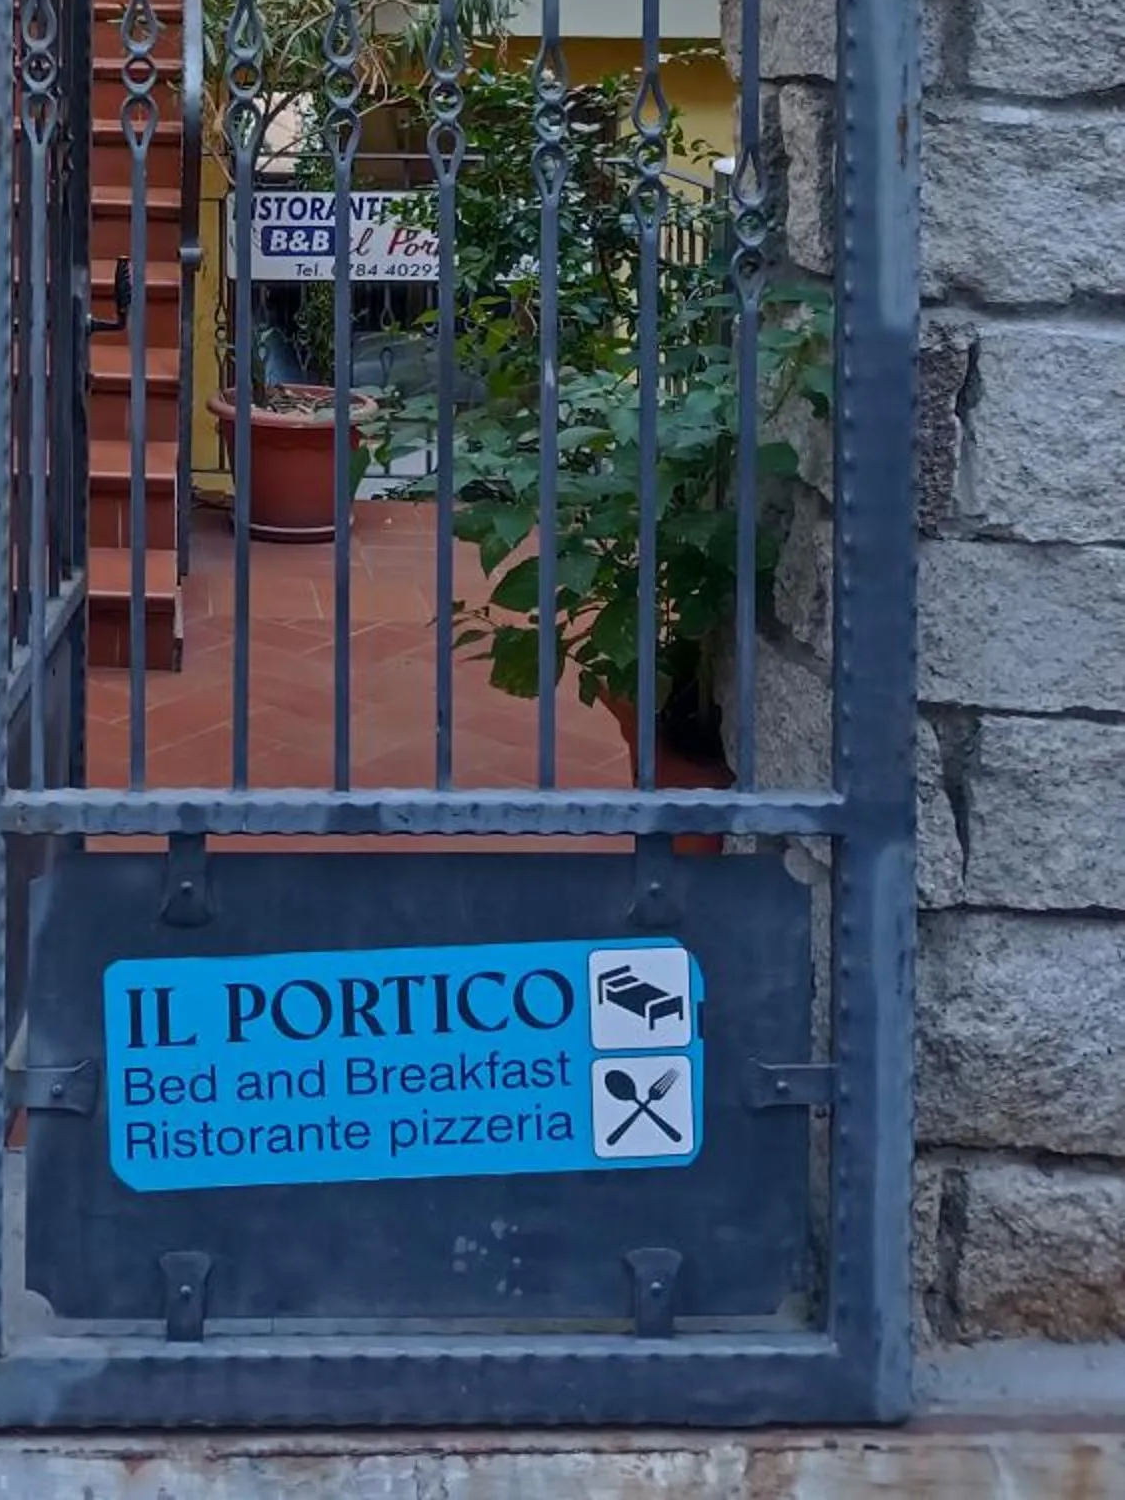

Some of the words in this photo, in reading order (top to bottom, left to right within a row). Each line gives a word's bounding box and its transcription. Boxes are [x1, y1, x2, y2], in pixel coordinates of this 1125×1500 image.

[270, 229, 331, 253] B&B
[295, 263, 324, 277] Tel.
[125, 986, 197, 1049] IL
[224, 968, 575, 1043] PORTICO
[124, 1064, 217, 1106] Bed
[236, 1060, 327, 1102] and
[345, 1049, 573, 1096] Breakfast
[125, 1114, 372, 1160] Ristorante
[389, 1103, 575, 1157] pizzeria
